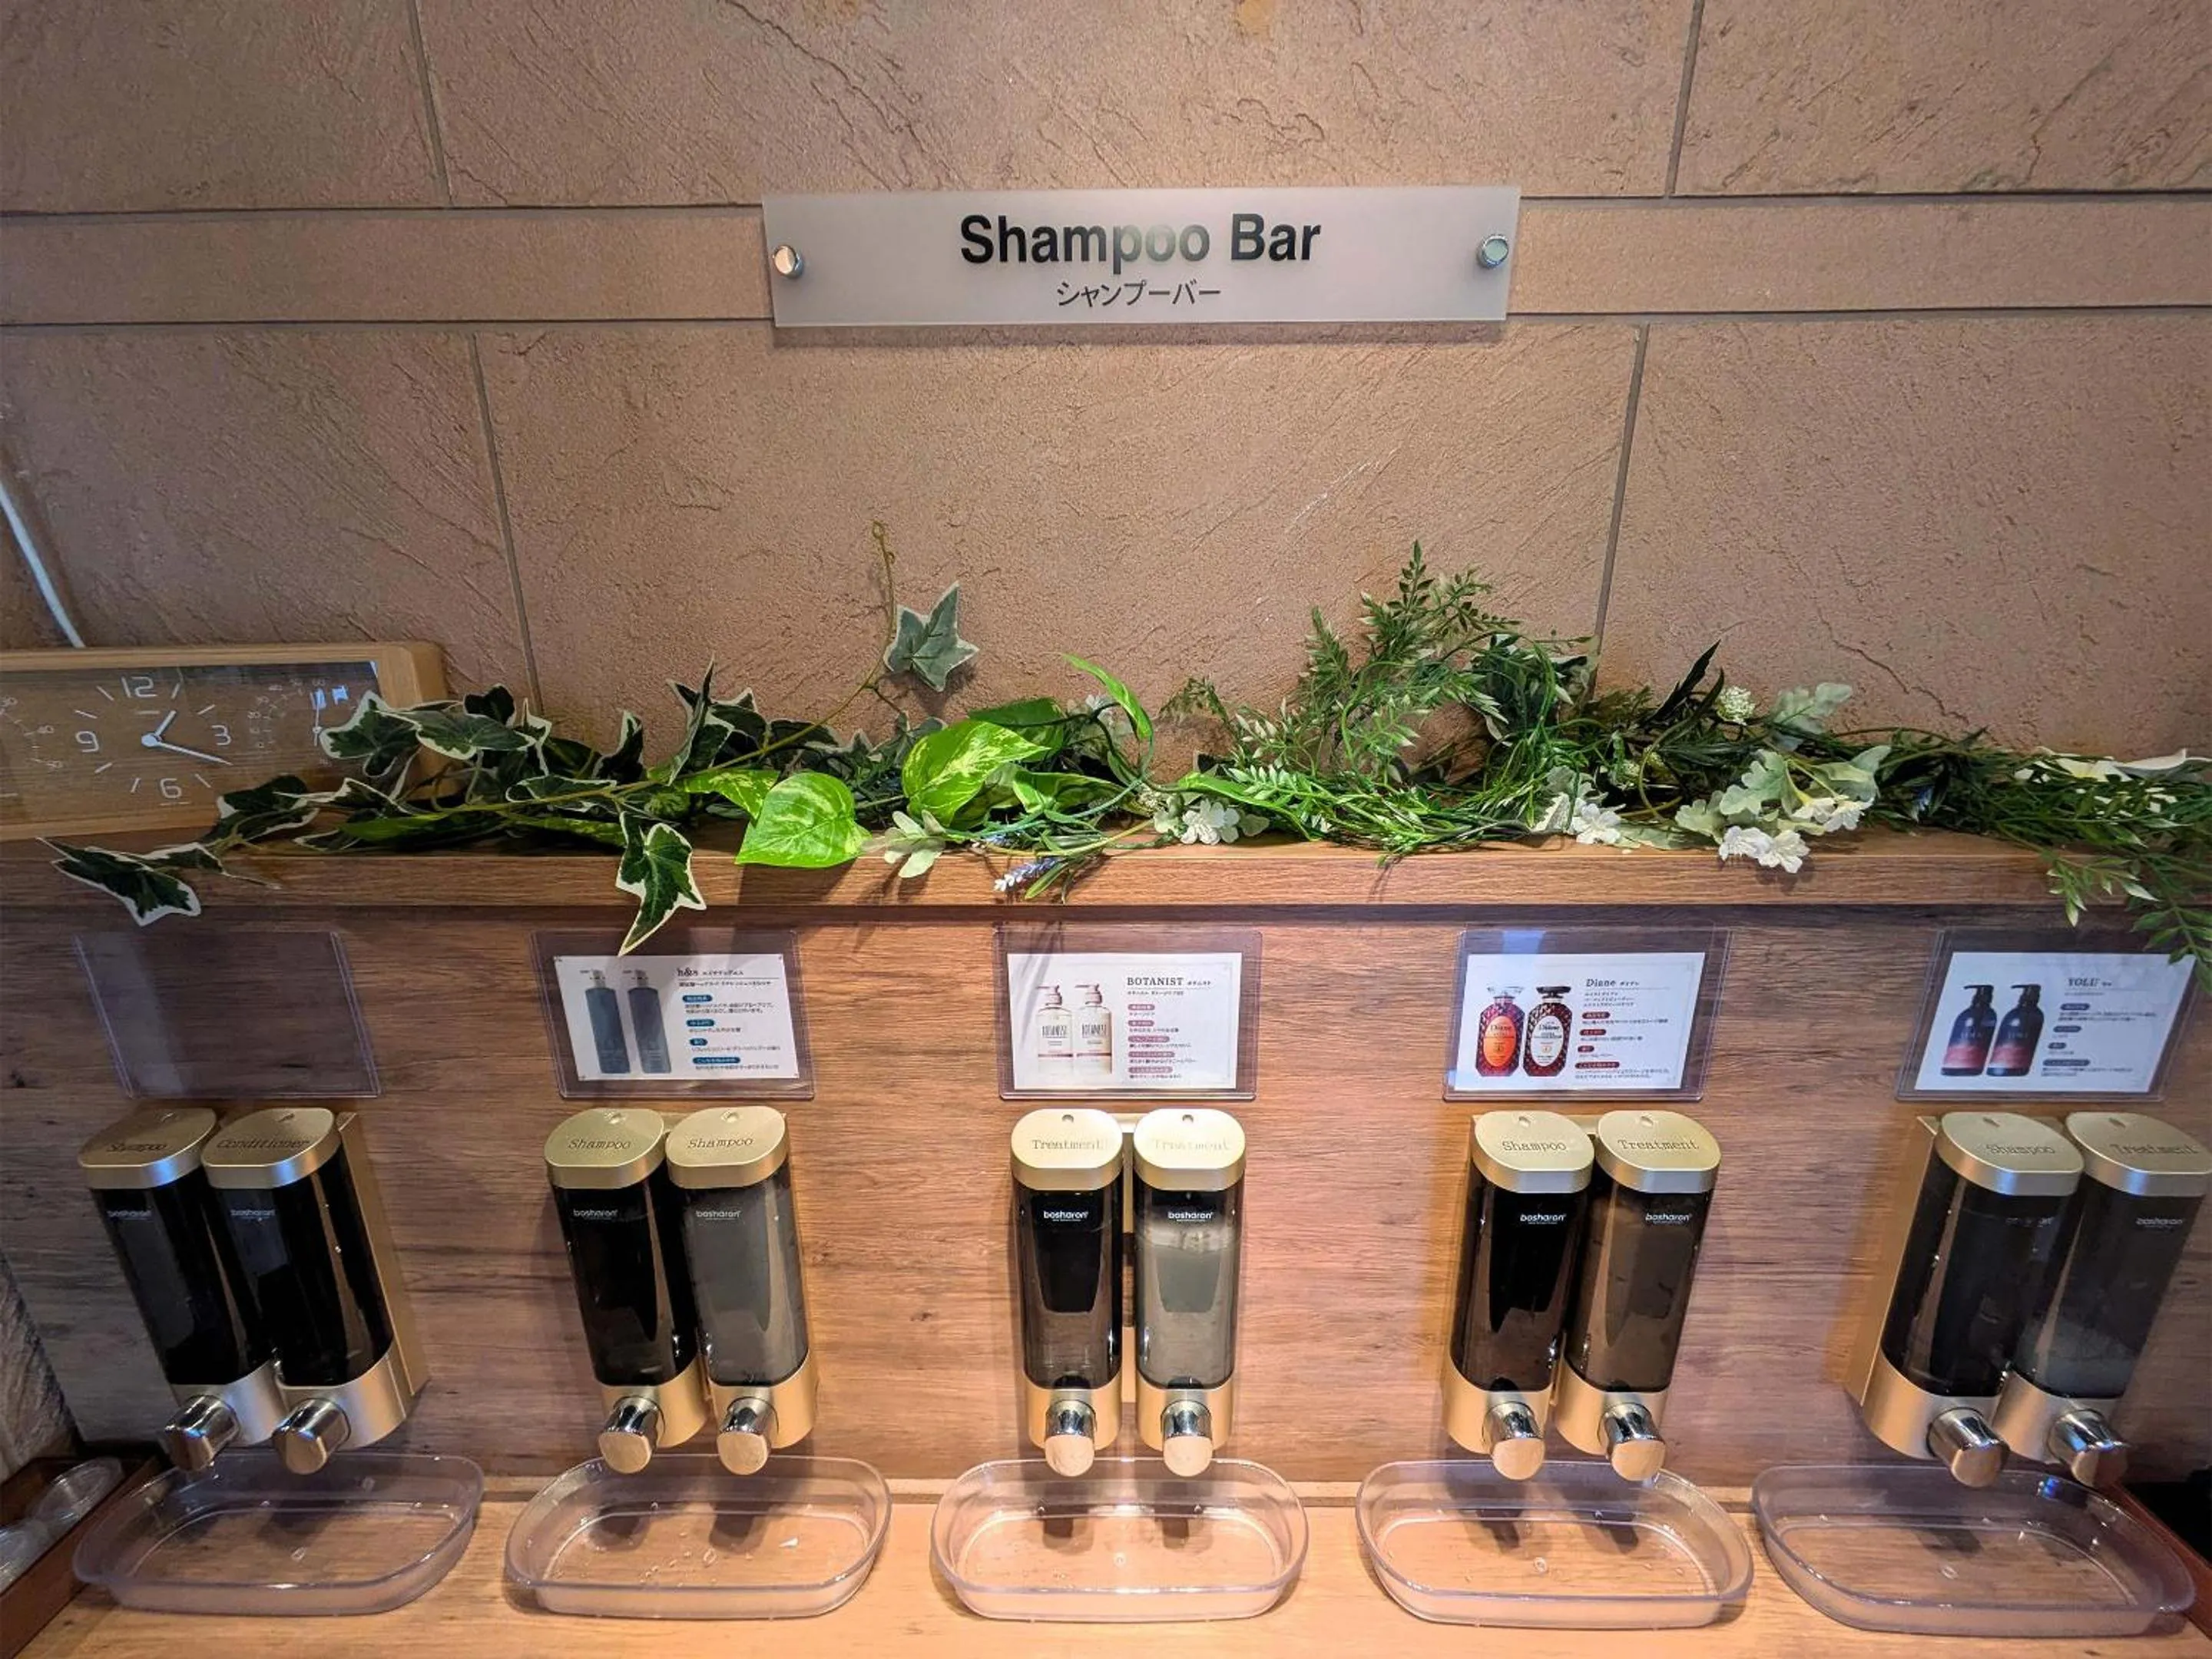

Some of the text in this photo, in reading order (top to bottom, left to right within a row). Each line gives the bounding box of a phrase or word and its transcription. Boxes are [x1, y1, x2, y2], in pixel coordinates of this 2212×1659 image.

[960, 213, 1321, 275] Shampoo Bar
[1056, 279, 1221, 307] シャンプーバー
[121, 677, 158, 699] 12
[75, 730, 100, 753] 9
[210, 725, 231, 746] 3
[160, 777, 182, 799] 6
[1127, 977, 1184, 986] BOTANIST
[568, 1138, 631, 1151] Shampoo
[687, 1136, 753, 1149] Shampoo
[1502, 1140, 1567, 1153] Shampoo
[1618, 1139, 1699, 1151] Treatment
